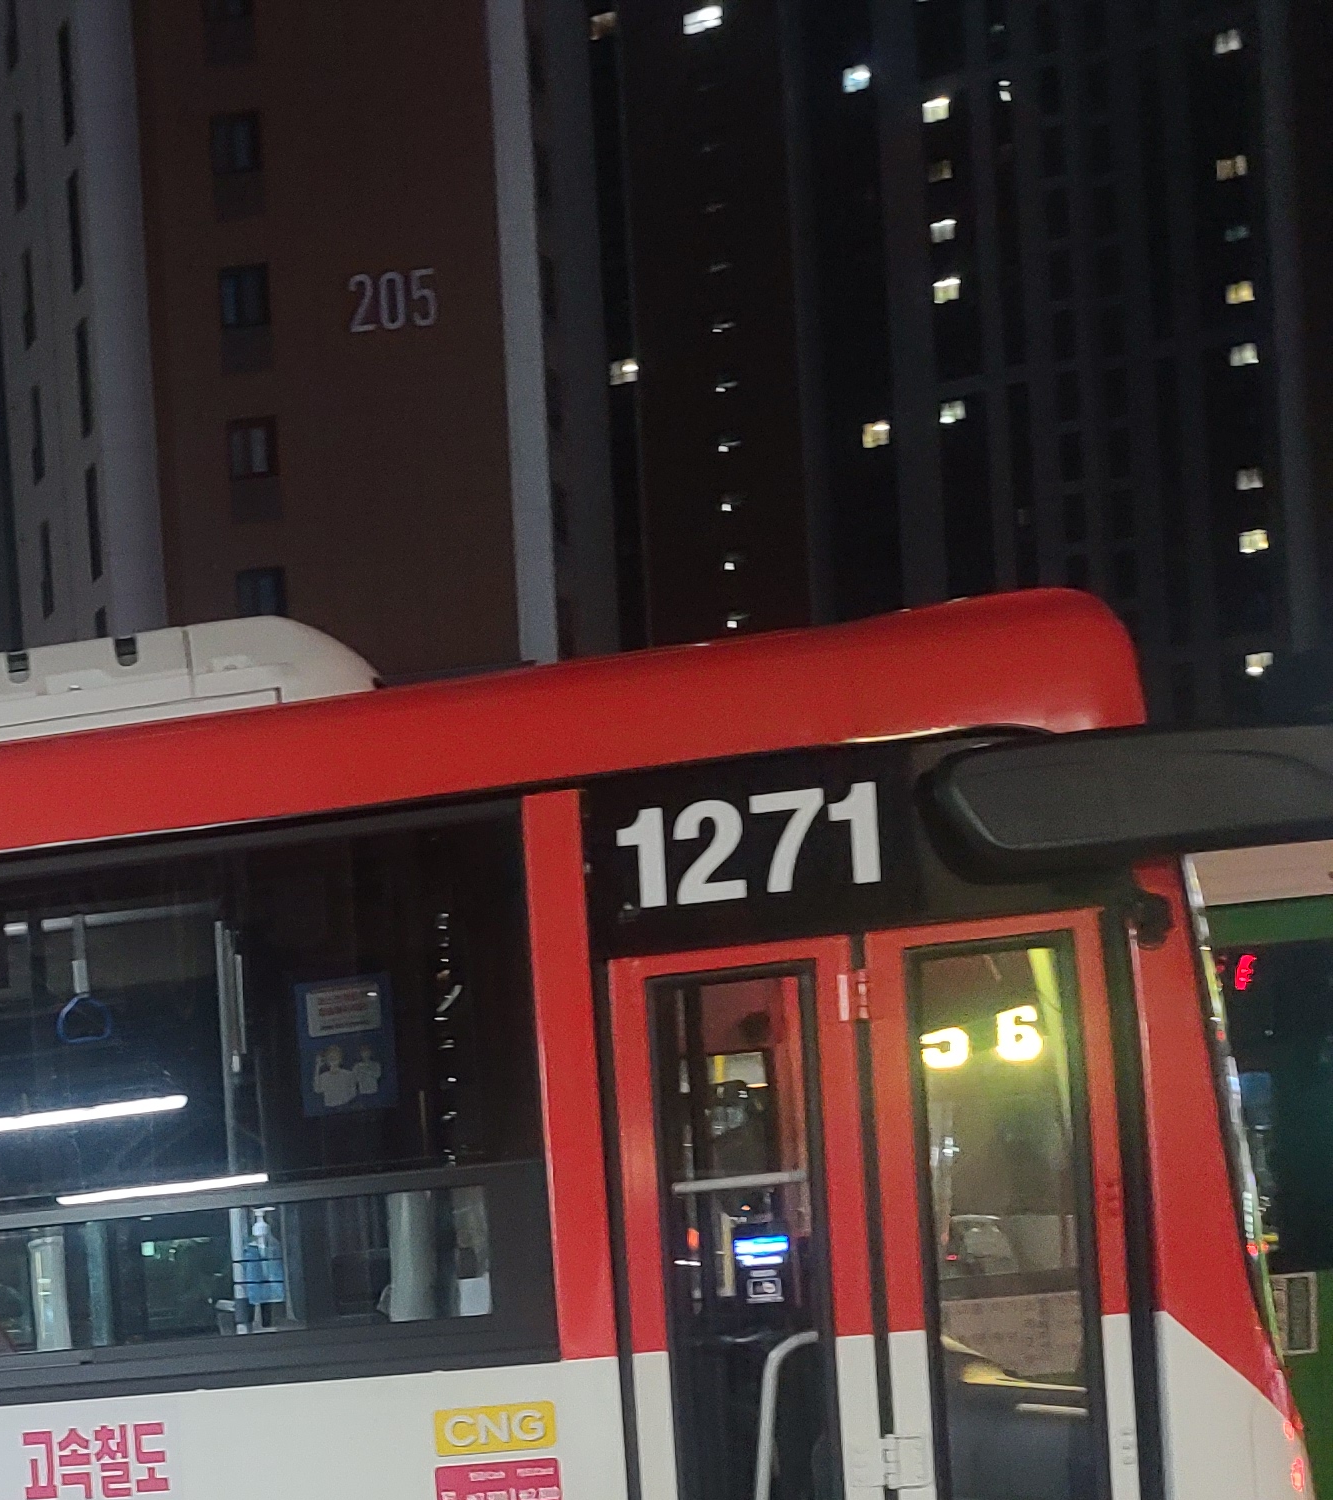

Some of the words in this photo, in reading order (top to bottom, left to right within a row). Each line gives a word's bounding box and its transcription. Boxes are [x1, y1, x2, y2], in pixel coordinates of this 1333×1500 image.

[348, 267, 438, 333] 205
[616, 781, 882, 909] 1271
[21, 1421, 171, 1500] 고속철도
[444, 1410, 546, 1447] CNG
